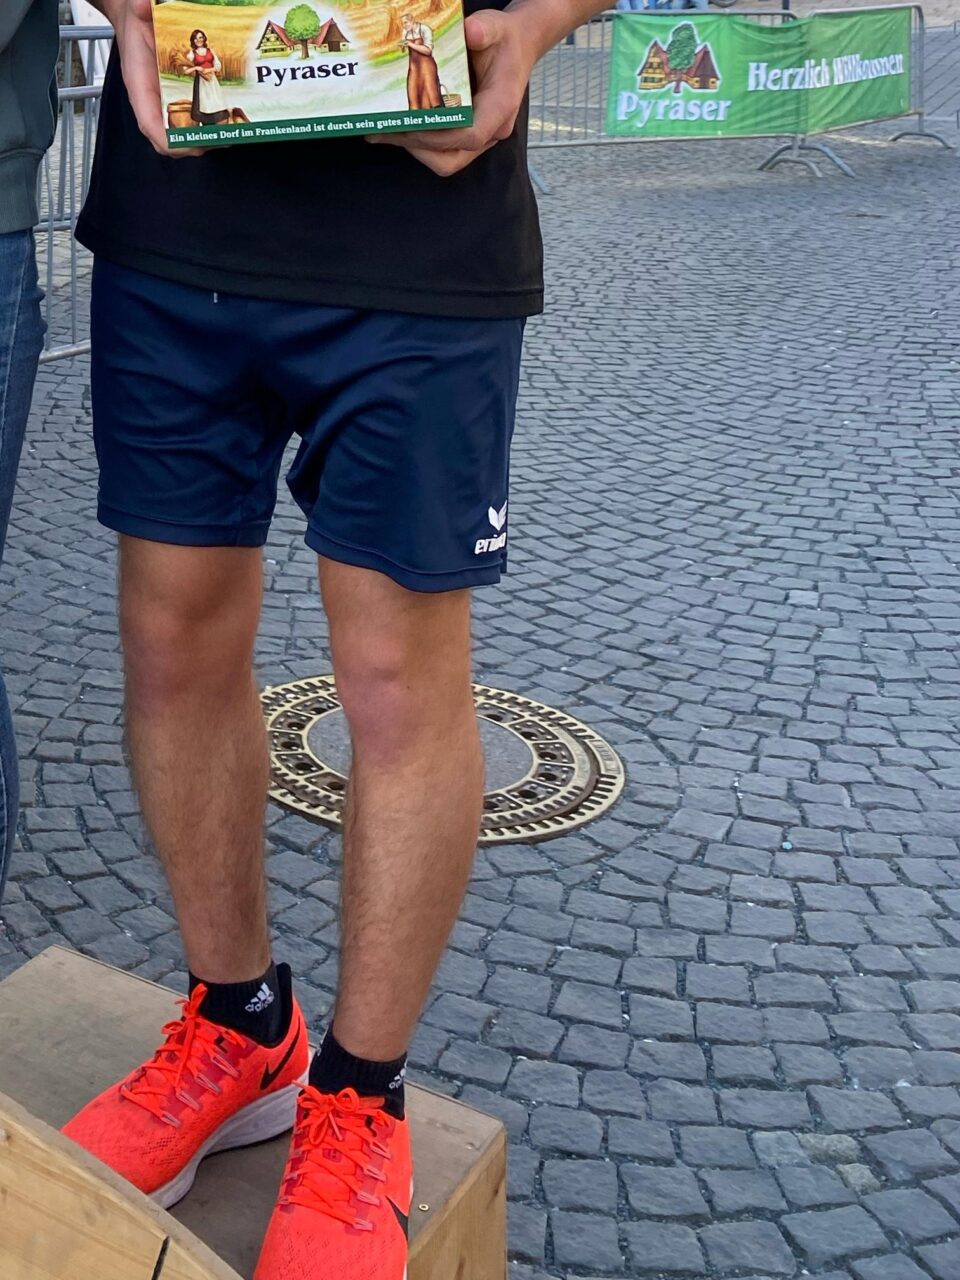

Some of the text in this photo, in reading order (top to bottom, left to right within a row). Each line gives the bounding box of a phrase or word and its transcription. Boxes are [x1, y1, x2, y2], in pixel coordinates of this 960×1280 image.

[255, 59, 358, 87] Pyraser
[748, 57, 830, 91] Herzlich
[617, 91, 732, 128] Pyraser
[169, 113, 466, 143] Ein kleines Dorf im Frankenland ist durch sein gutes Bier bekannt.
